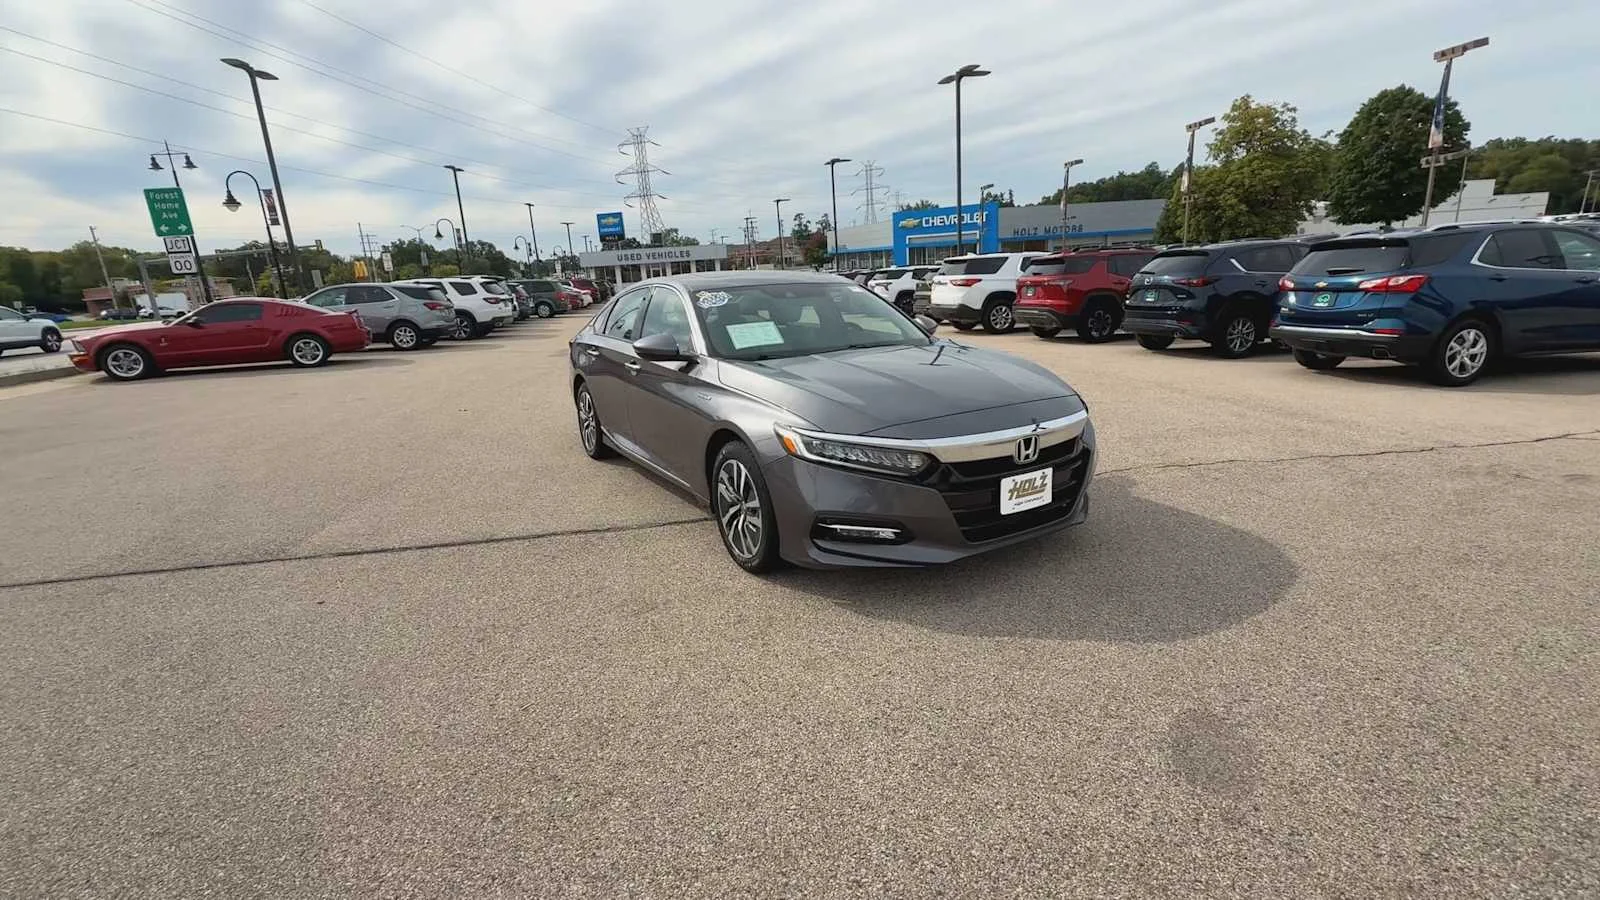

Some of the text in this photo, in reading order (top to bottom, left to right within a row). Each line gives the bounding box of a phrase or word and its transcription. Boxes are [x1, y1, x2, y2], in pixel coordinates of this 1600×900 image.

[149, 191, 179, 200] Forest
[161, 211, 179, 219] Ave
[922, 211, 989, 227] CHEVROLET
[1013, 224, 1083, 236] HOLZ MOTORS
[168, 239, 187, 250] JCT
[617, 250, 691, 262] USED VEHICLES
[1008, 475, 1049, 501] HOLZ
